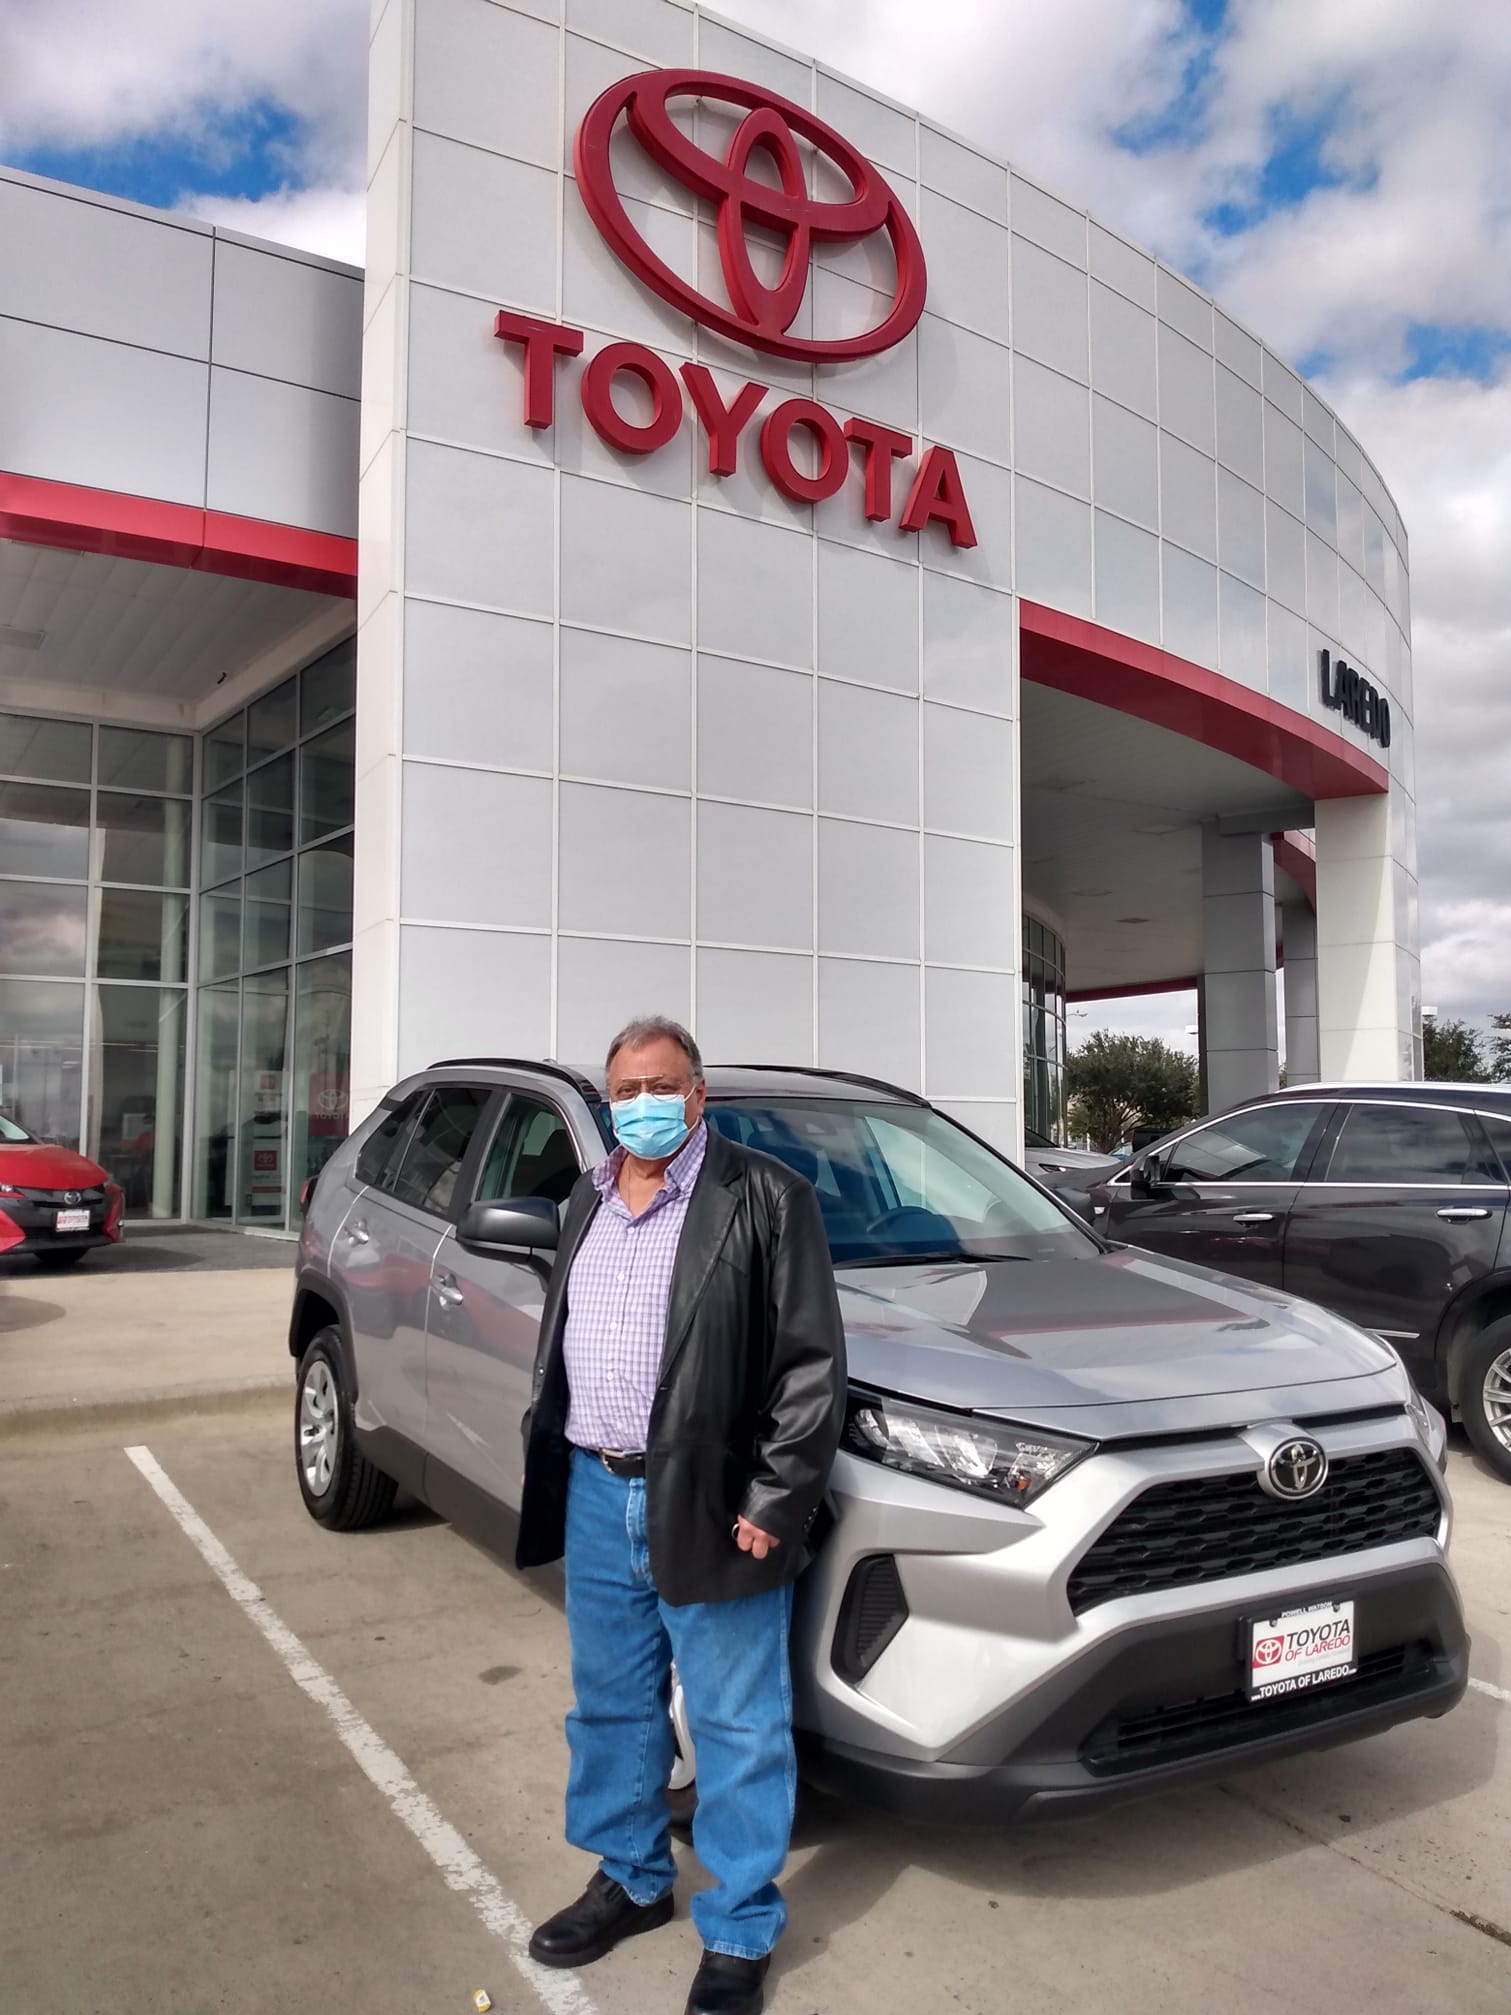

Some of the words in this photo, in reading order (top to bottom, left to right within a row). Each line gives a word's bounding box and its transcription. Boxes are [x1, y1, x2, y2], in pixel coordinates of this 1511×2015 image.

[494, 310, 978, 548] TOYOTA
[1321, 649, 1390, 748] LAREDO
[1285, 1648, 1302, 1661] OF
[1305, 1635, 1350, 1656] LAREDO
[1286, 1619, 1350, 1649] TOYOTA
[1260, 1680, 1296, 1698] TOYOTA
[1298, 1676, 1311, 1687] OF
[1312, 1665, 1349, 1683] LAREDO
